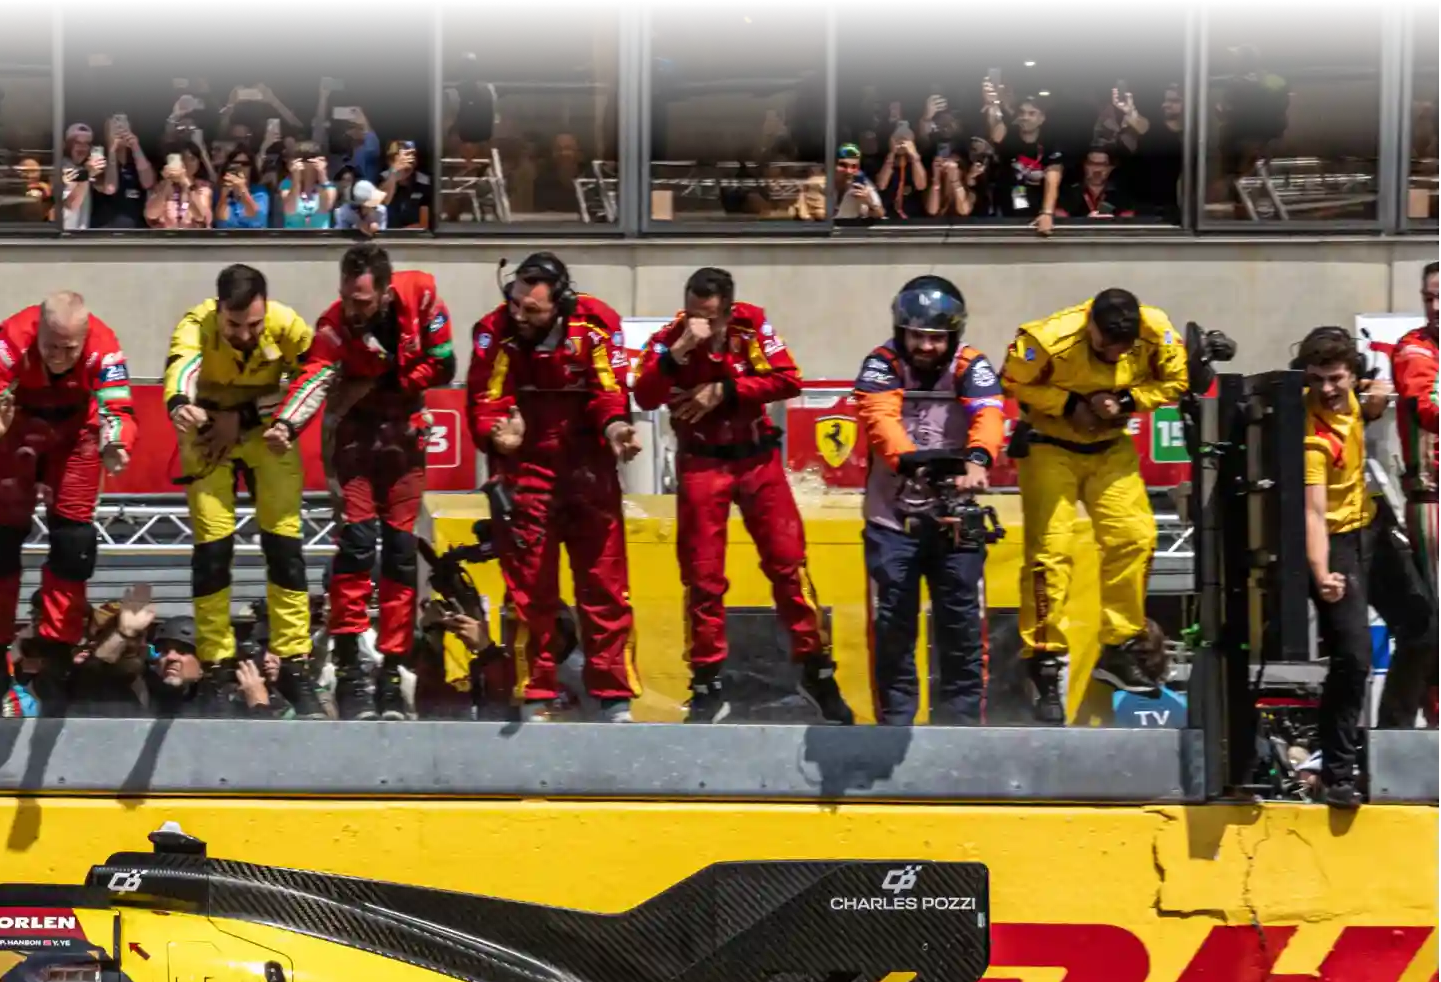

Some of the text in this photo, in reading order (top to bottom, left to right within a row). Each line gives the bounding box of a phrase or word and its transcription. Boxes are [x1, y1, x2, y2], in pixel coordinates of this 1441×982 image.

[1134, 710, 1170, 726] TV
[830, 897, 976, 910] CHARLES POZZI
